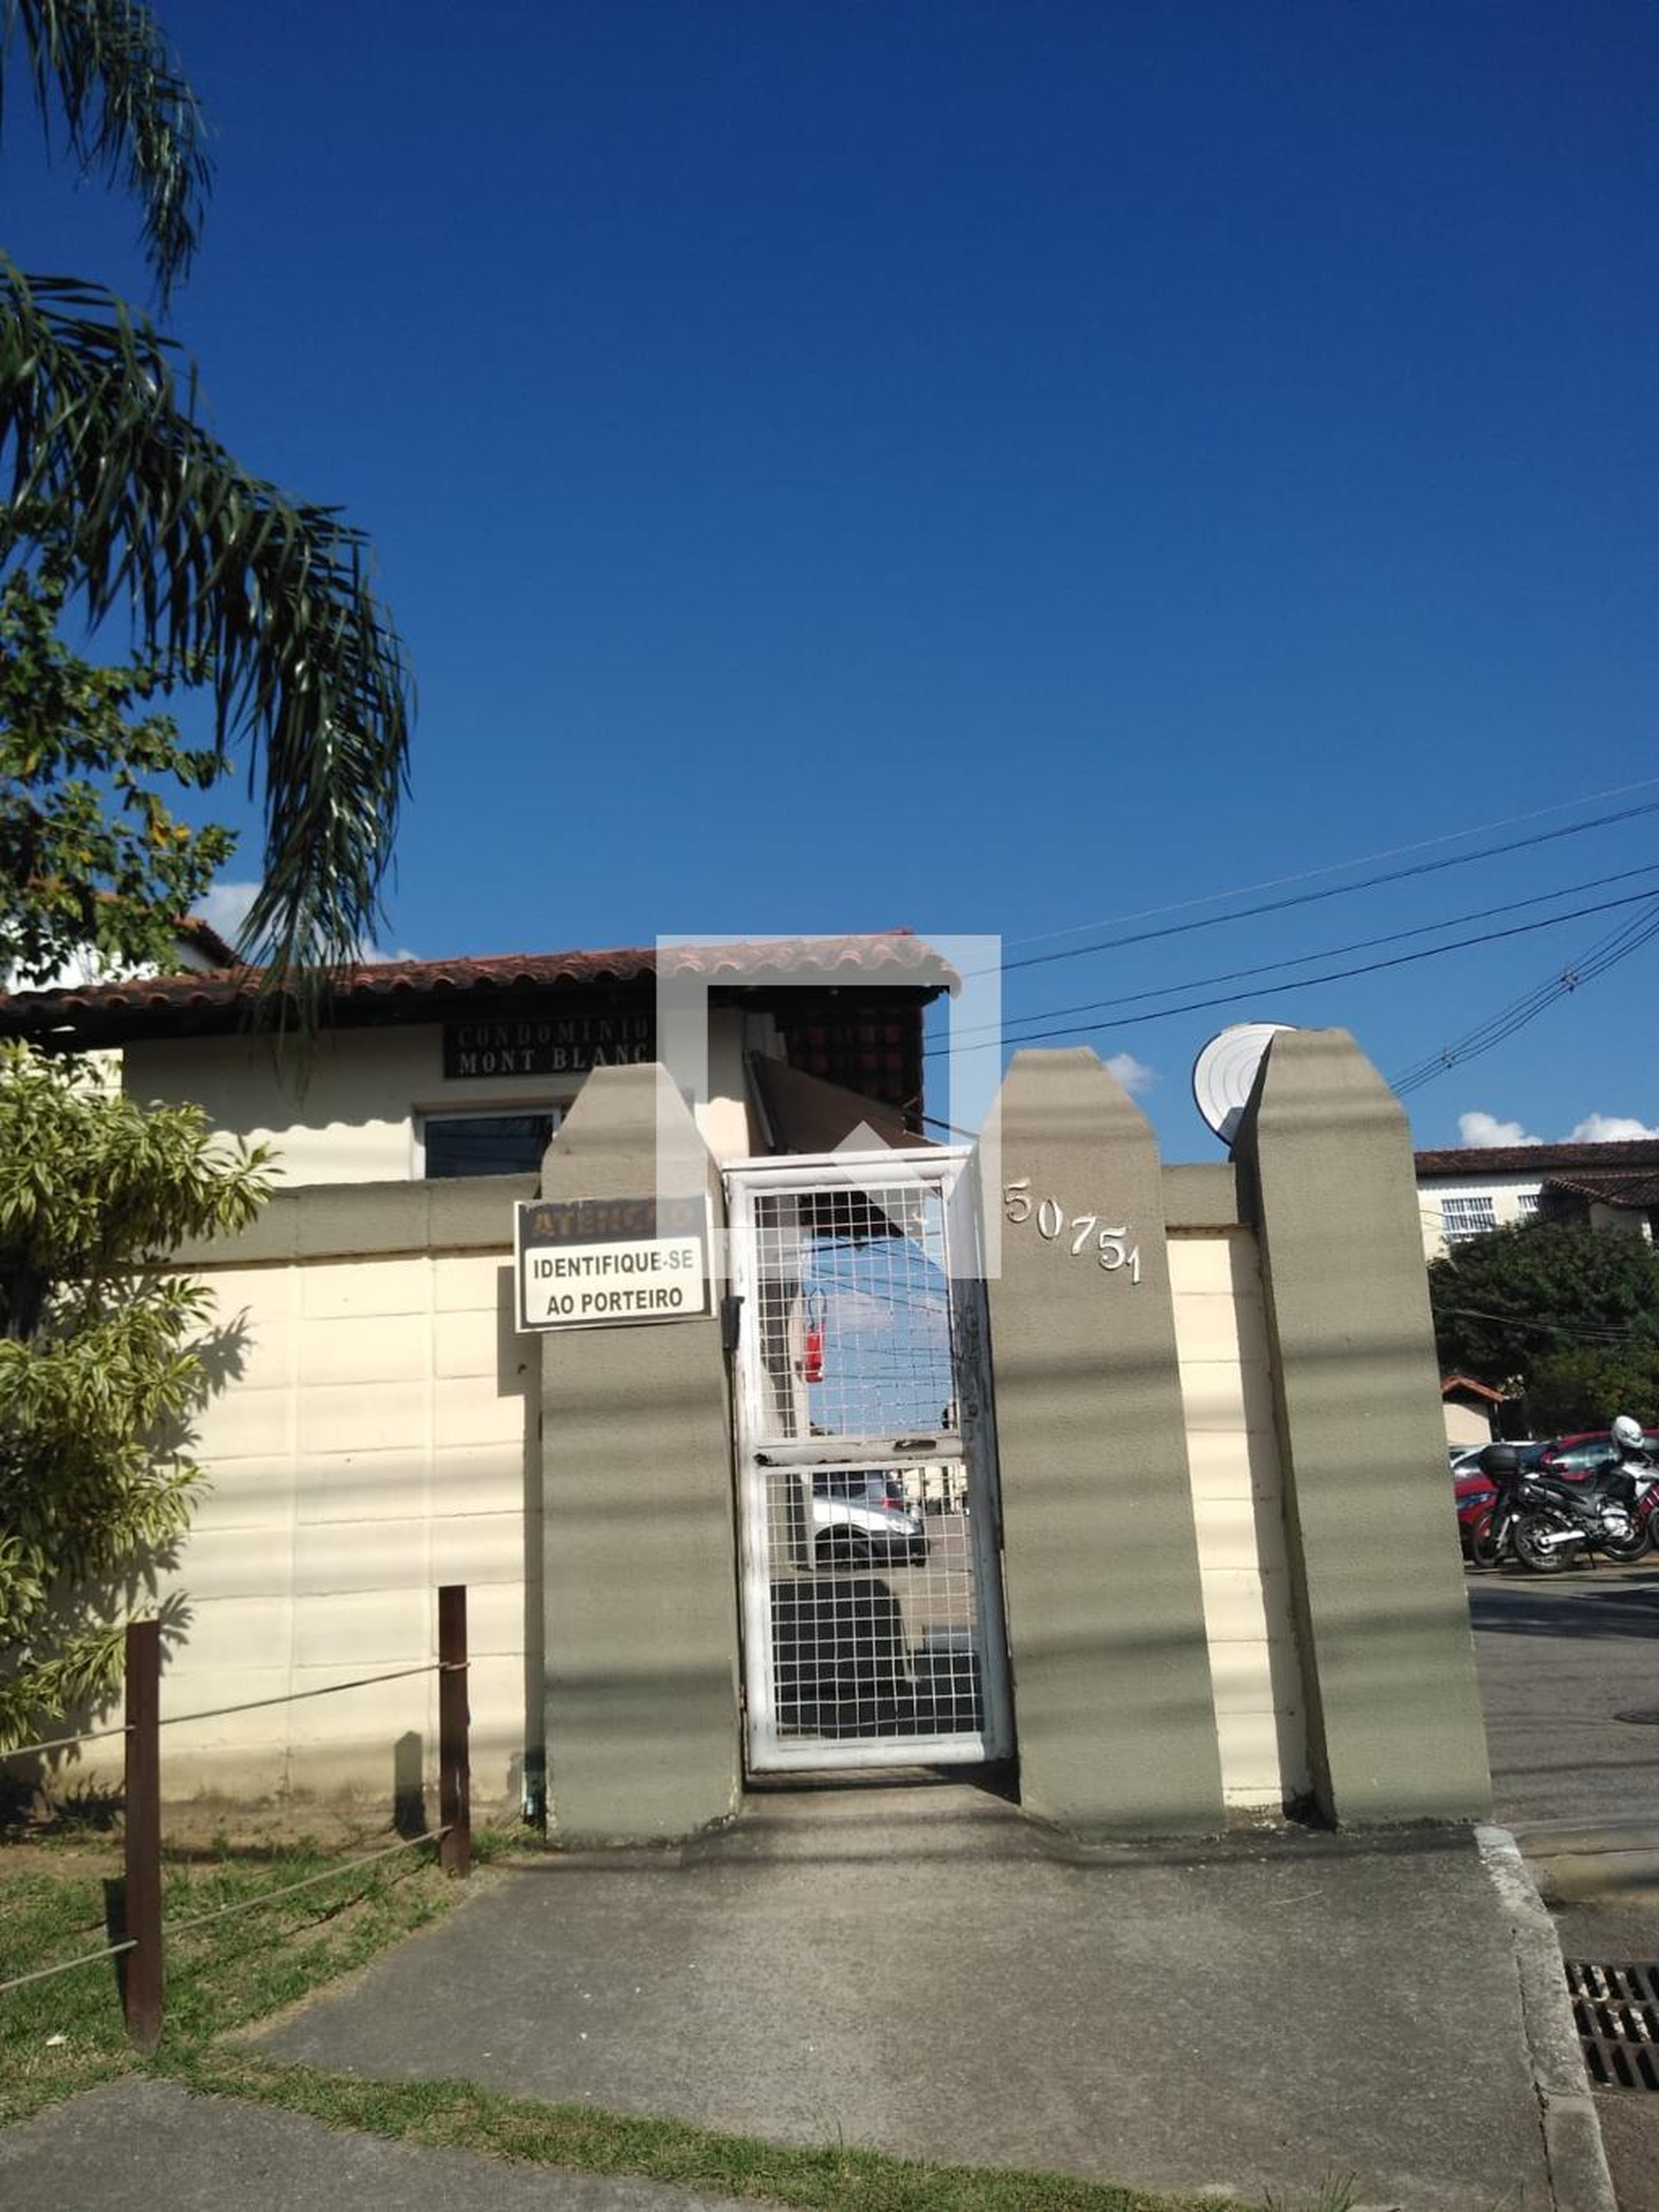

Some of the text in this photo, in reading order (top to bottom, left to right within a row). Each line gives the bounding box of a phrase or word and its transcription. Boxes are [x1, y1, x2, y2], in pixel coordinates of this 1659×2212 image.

[459, 1043, 648, 1075] MONT BLANC
[1004, 1177, 1141, 1285] 50751
[534, 1250, 693, 1279] IDENTIFIQUE-SE
[547, 1288, 683, 1315] AO PORTEIRO
